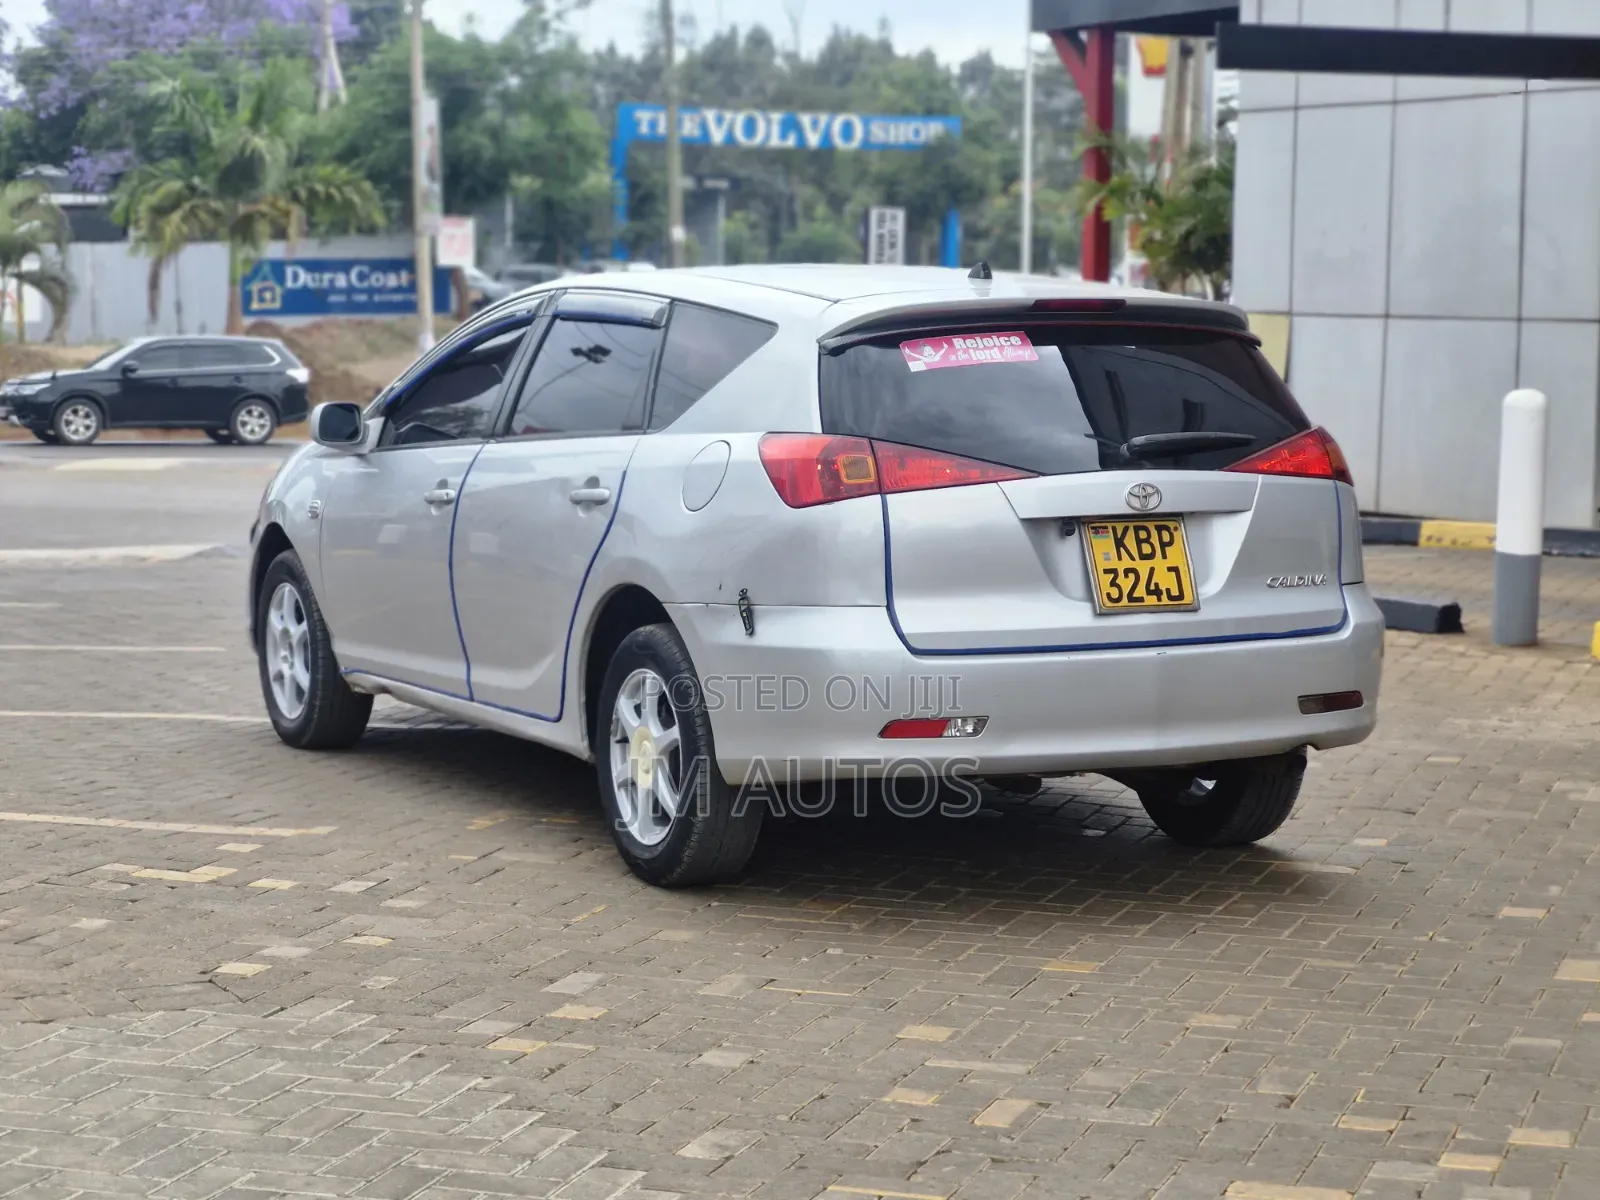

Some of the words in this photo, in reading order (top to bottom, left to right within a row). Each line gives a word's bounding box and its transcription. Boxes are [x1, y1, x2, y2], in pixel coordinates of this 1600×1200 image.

[702, 107, 863, 150] VOLVO
[870, 120, 945, 144] SHOP
[952, 335, 1022, 350] Rejoice
[1111, 524, 1176, 562] KBP
[1102, 565, 1185, 604] 324J
[1266, 573, 1327, 588] CALDINA
